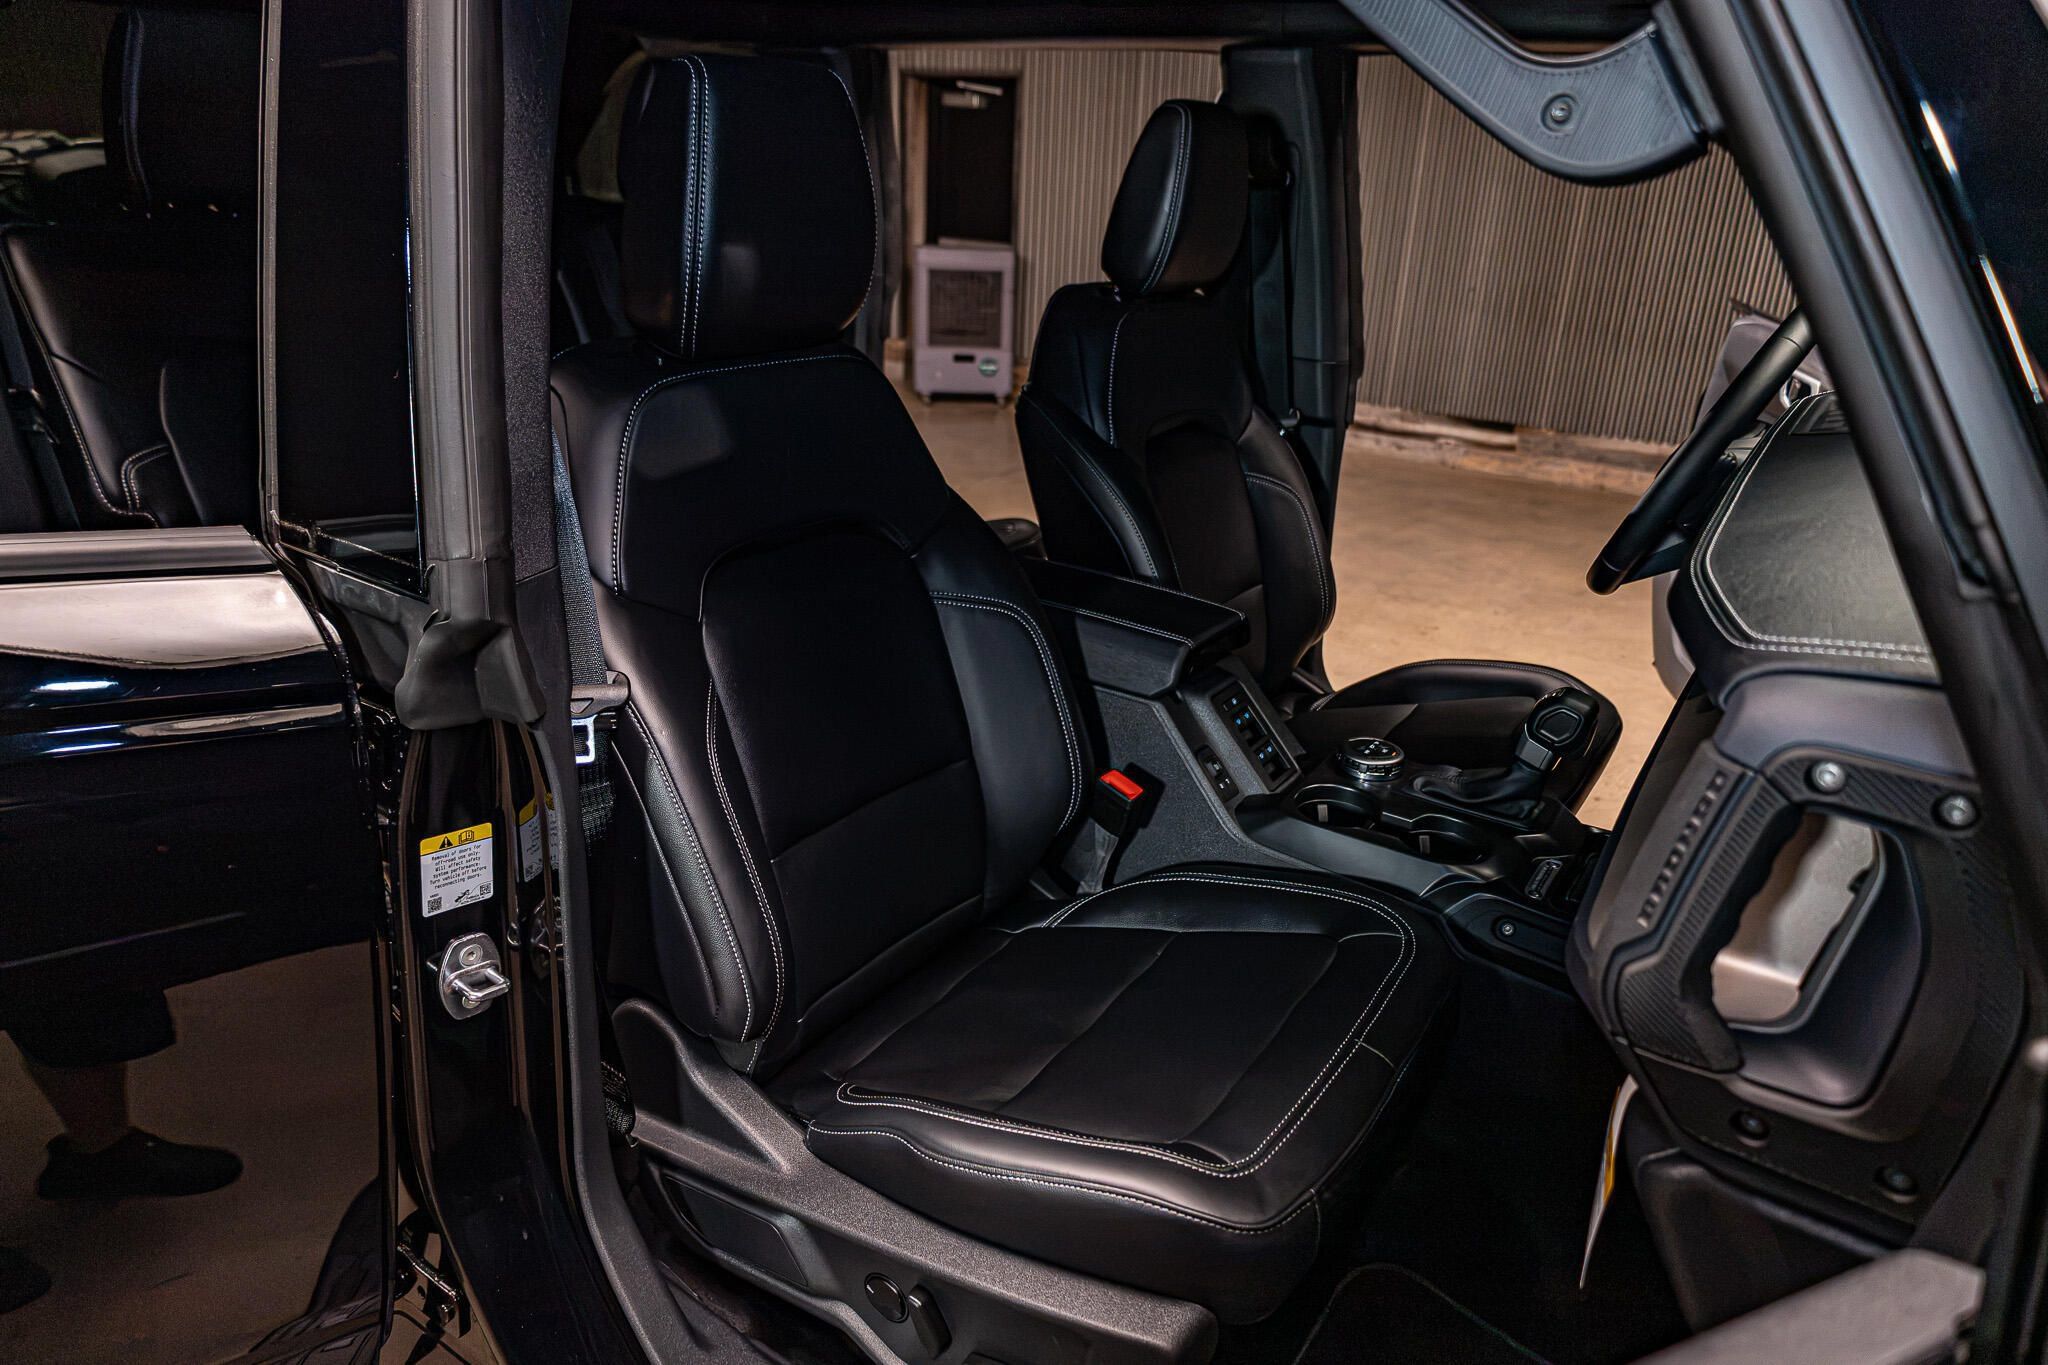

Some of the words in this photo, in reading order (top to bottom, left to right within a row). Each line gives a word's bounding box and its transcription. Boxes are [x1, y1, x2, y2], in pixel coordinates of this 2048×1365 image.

[434, 857, 457, 866] off-road
[448, 860, 464, 868] affect
[465, 856, 481, 864] safety
[433, 870, 449, 879] system
[441, 873, 460, 882] vehicle
[471, 865, 487, 873] before
[434, 878, 466, 890] reconnecting
